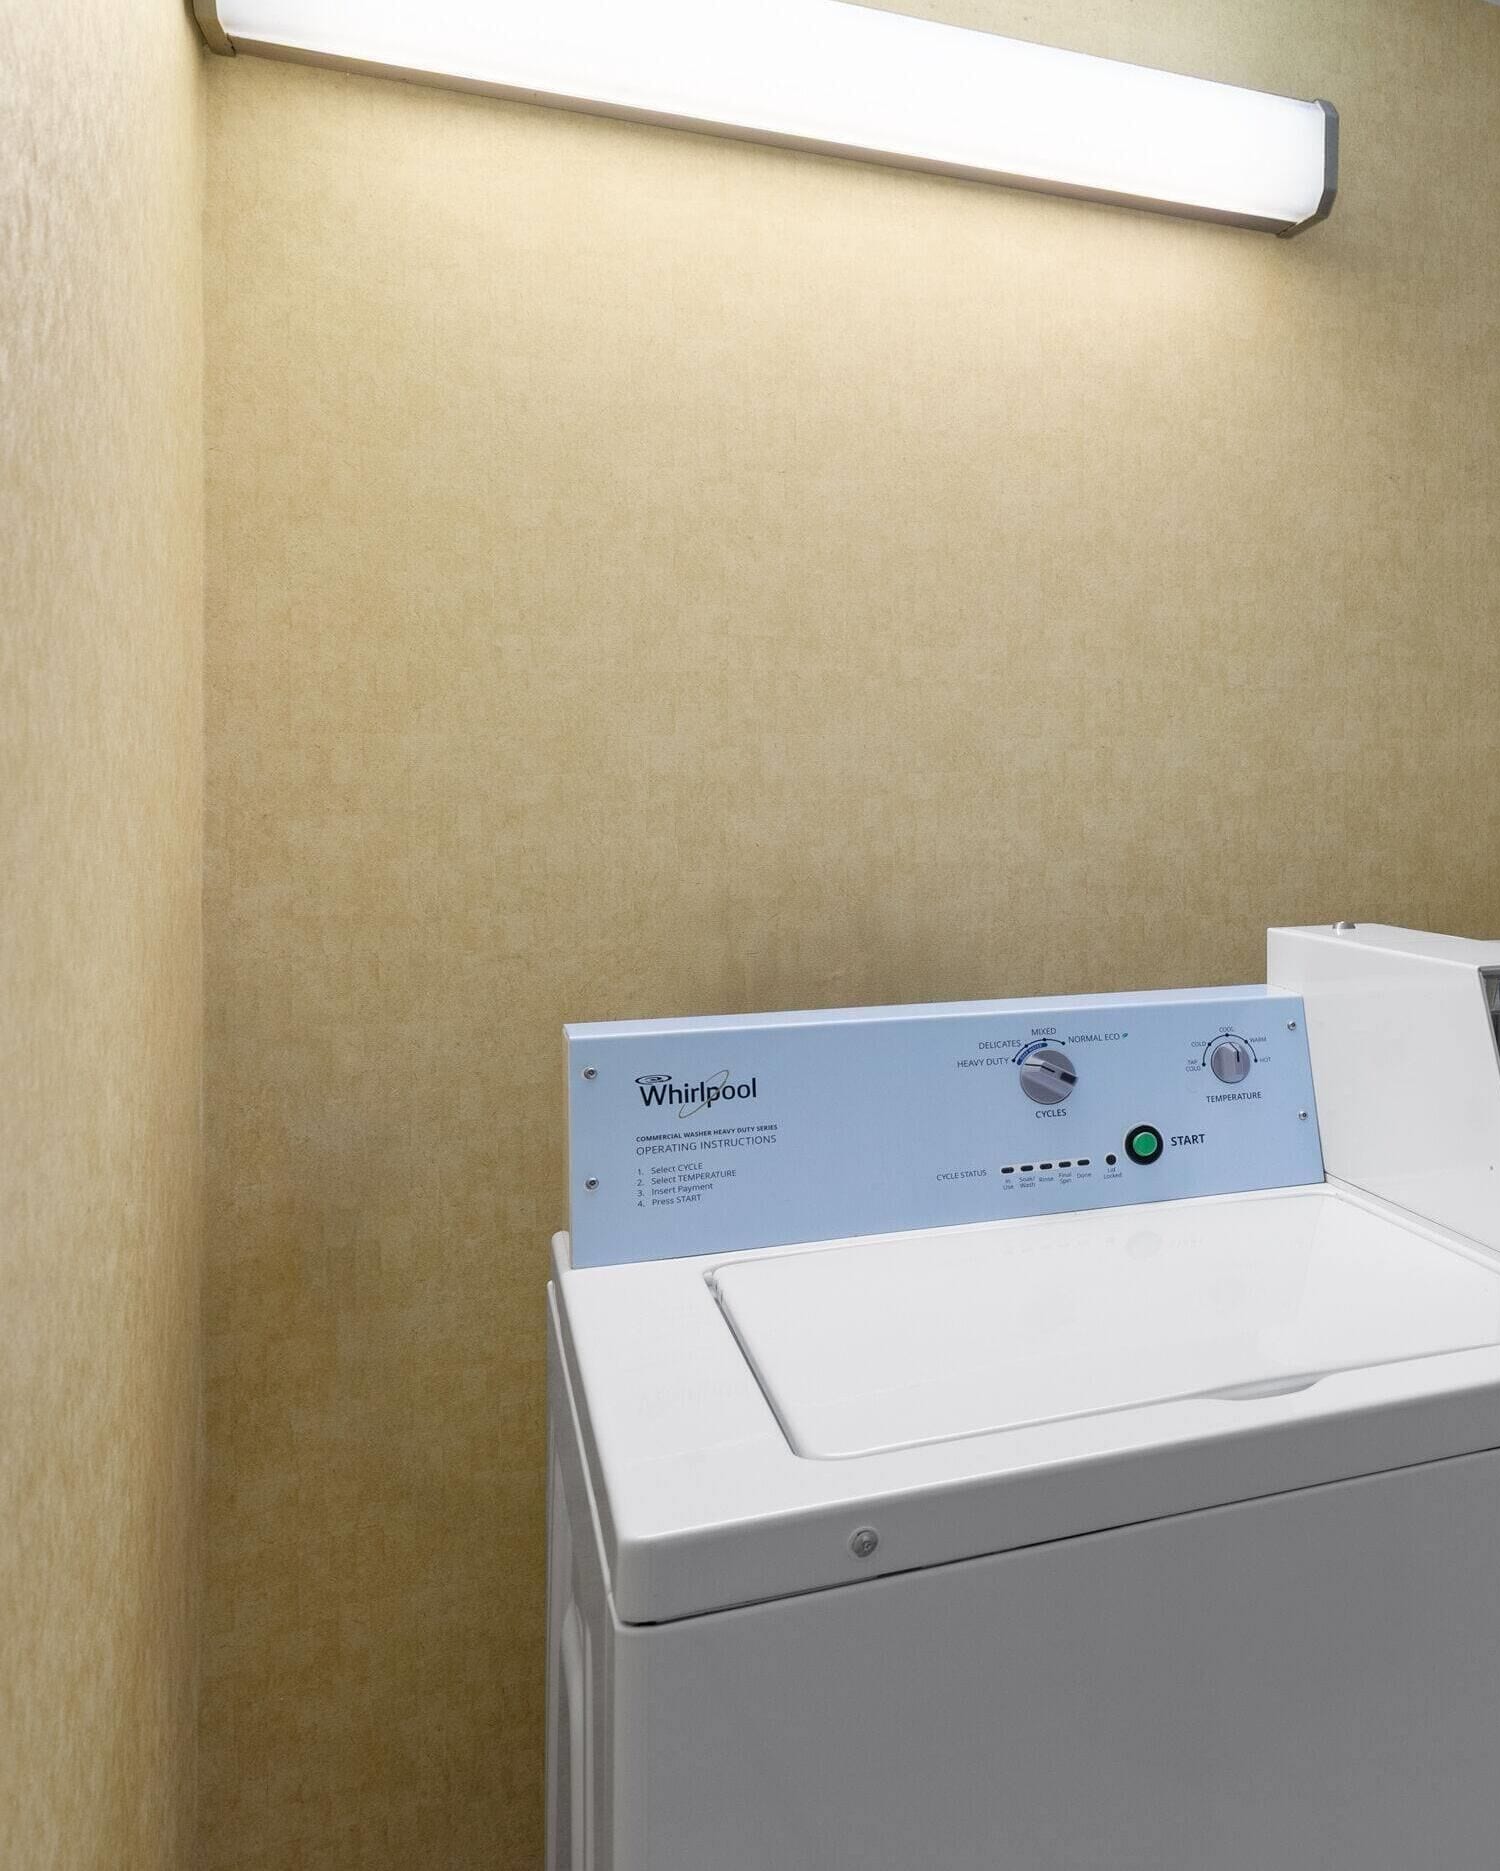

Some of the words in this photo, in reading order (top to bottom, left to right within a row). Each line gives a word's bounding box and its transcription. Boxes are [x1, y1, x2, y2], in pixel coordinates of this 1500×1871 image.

[1031, 1027, 1057, 1036] MIXED
[1068, 1034, 1102, 1043] NORMAL
[1104, 1032, 1120, 1041] ECO
[978, 1039, 1022, 1050] DELICATES
[957, 1059, 985, 1068] HEAVY
[986, 1057, 1009, 1066] DUTY
[639, 1077, 757, 1109] Whirlpool
[1206, 1091, 1262, 1103] TEMPERATURE
[1035, 1108, 1067, 1119] CYCLES
[636, 1132, 682, 1143] COMMERCIAL
[684, 1130, 712, 1139] WASHER
[713, 1128, 735, 1136] HEAVY
[737, 1126, 755, 1134] DUTY
[756, 1124, 778, 1132] SERIES
[1170, 1133, 1206, 1147] START
[636, 1142, 698, 1156] OPERATING
[700, 1134, 777, 1150] INSTRUCTIONS
[651, 1166, 676, 1175] Select
[677, 1162, 704, 1172] CYCLE
[651, 1176, 677, 1185] Select
[678, 1169, 737, 1182] TEMPERATURE
[936, 1173, 960, 1182] CYCLE
[960, 1169, 988, 1179] STATUS
[637, 1189, 645, 1197] 3.
[652, 1186, 676, 1196] Insert
[678, 1183, 714, 1194] Payment
[637, 1200, 646, 1208] 4.
[652, 1198, 675, 1206] Press
[676, 1194, 702, 1204] START
